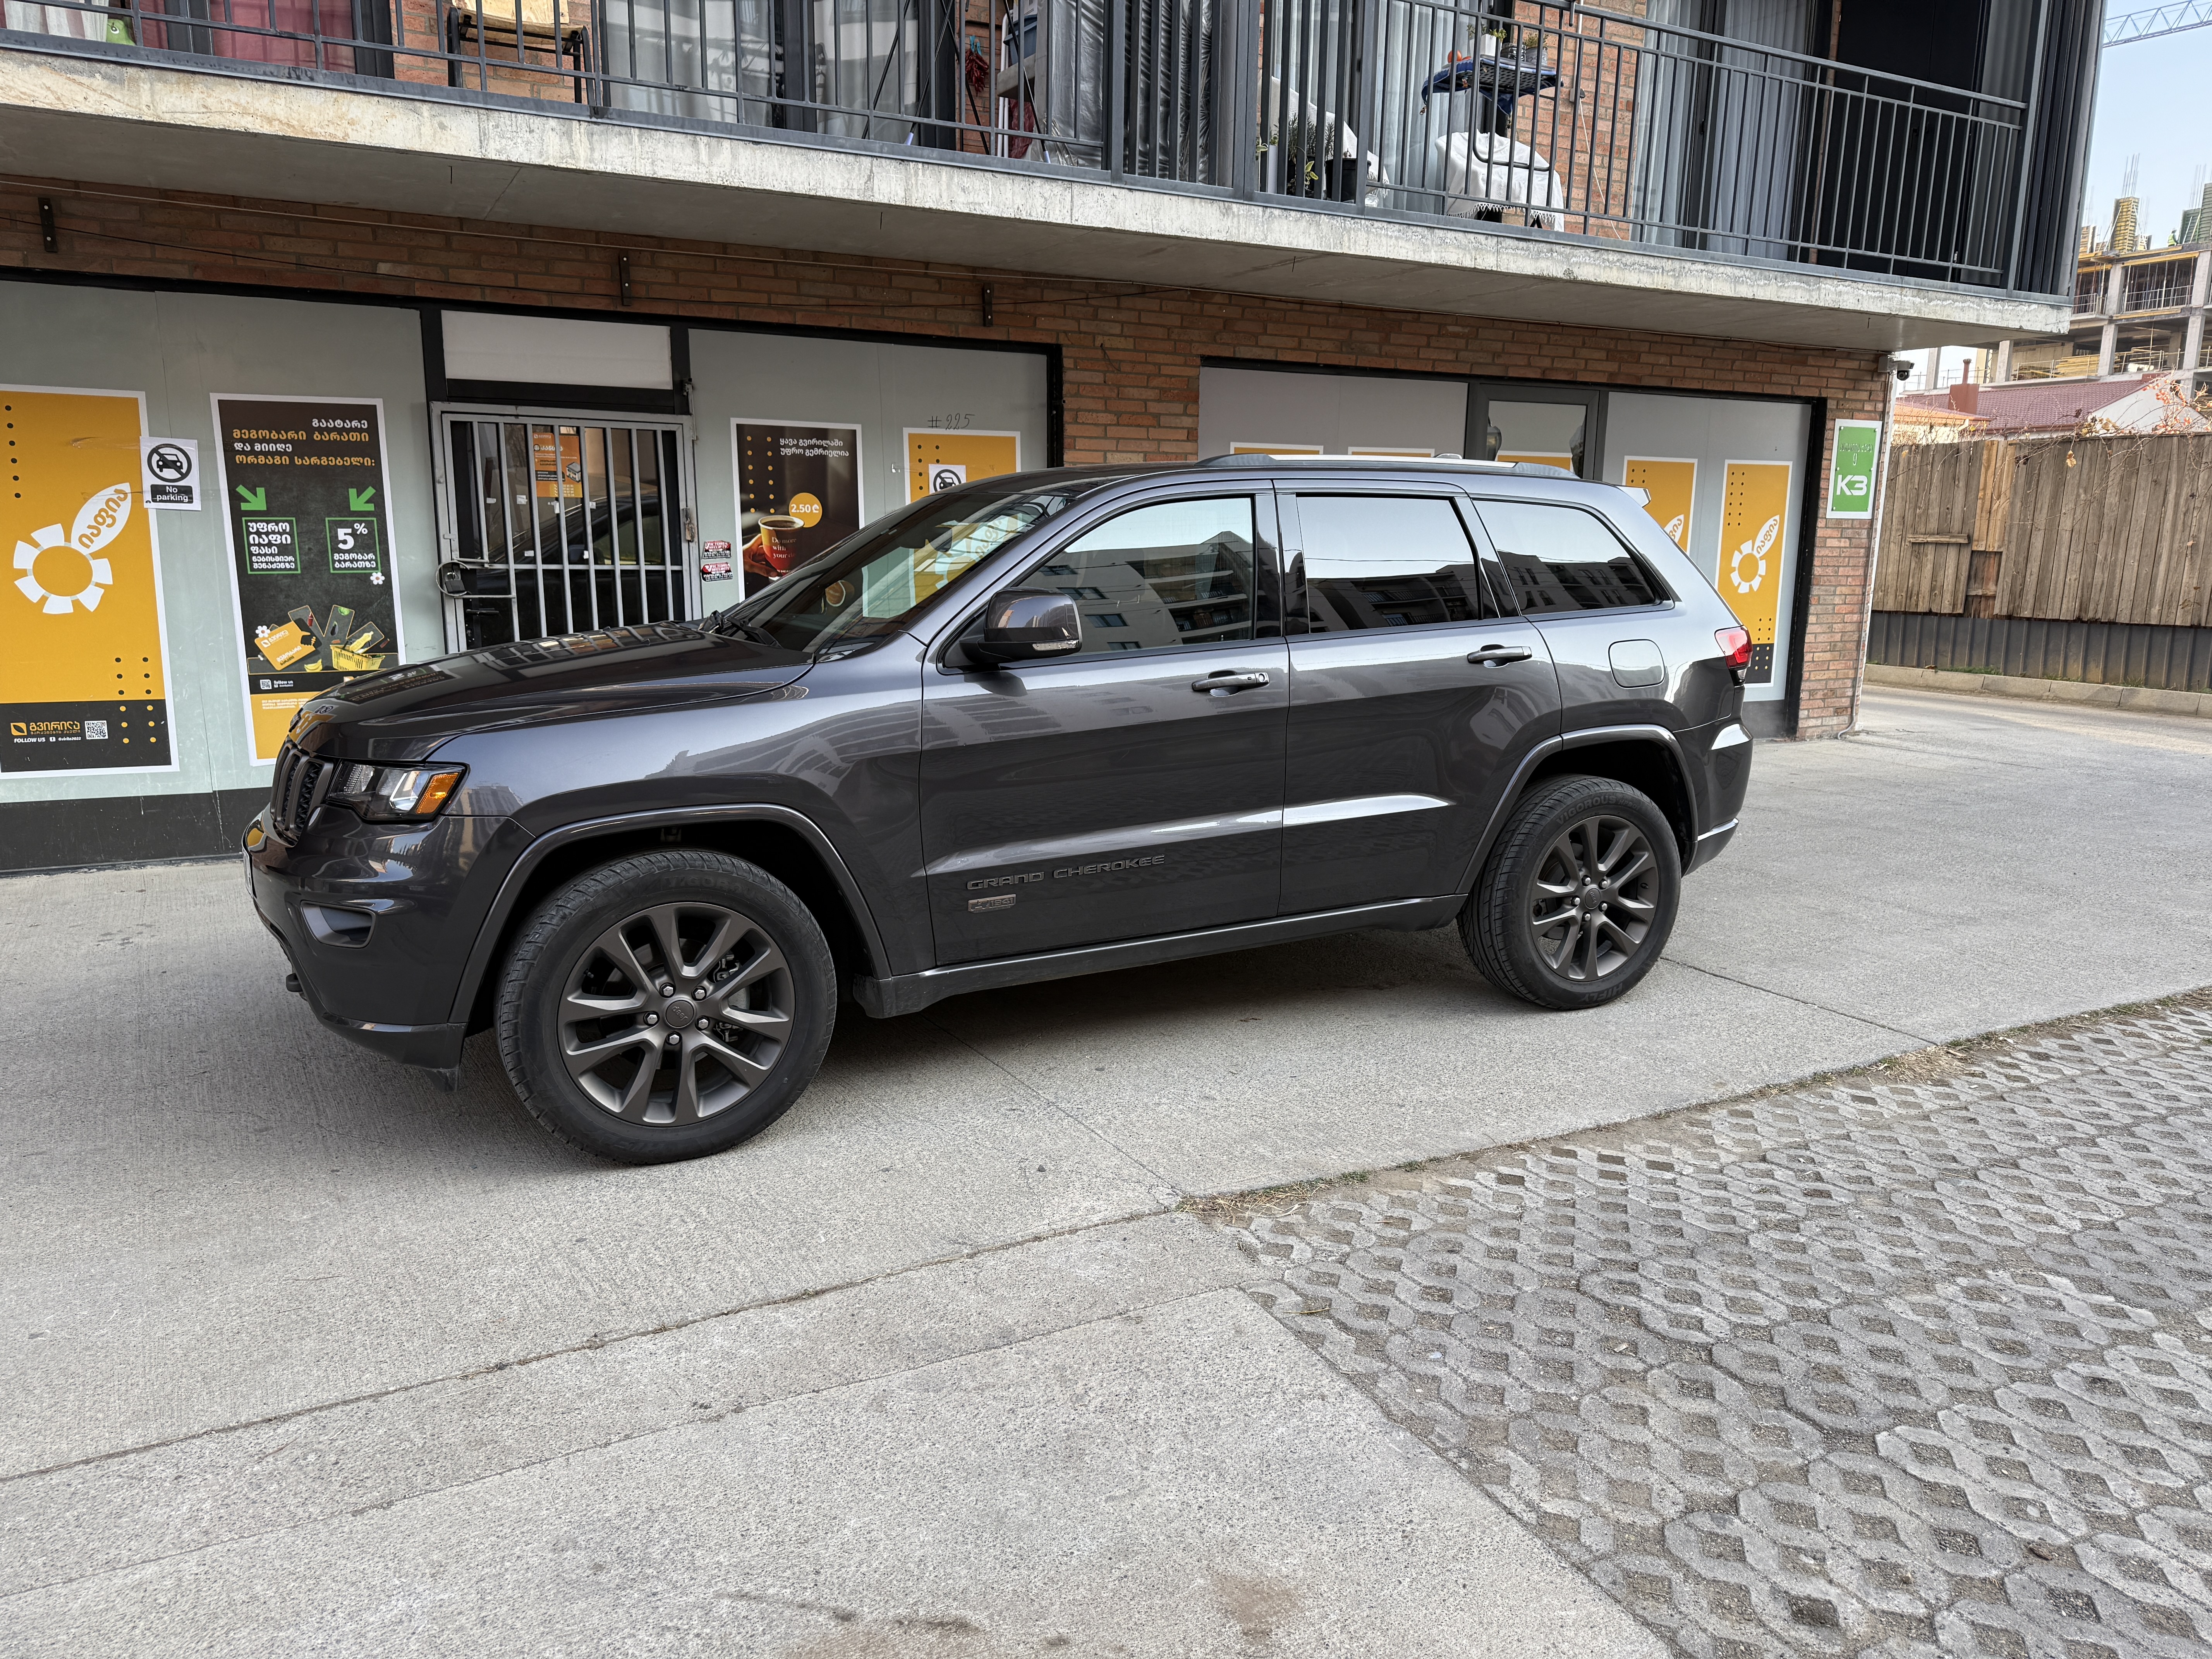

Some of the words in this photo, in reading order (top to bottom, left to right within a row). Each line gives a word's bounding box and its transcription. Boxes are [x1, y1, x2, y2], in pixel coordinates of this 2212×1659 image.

[312, 419, 368, 429] გაატარე
[233, 429, 306, 440] მეგობარი
[313, 431, 369, 441] ბარათი
[234, 443, 251, 451] და
[254, 443, 292, 452] მიიღე
[799, 438, 843, 447] გვირილაში
[780, 447, 804, 455] უფრო
[805, 448, 849, 457] გემრიელია
[235, 455, 289, 464] ორმაგი
[294, 456, 375, 466] სარგებელი:
[1836, 474, 1868, 496] K3
[156, 494, 188, 502] parking
[791, 504, 811, 513] 2.50
[78, 488, 128, 549] იაფია
[248, 522, 290, 532] უფრო
[249, 534, 291, 544] იაფი
[1756, 519, 1778, 555] იაფია
[1556, 795, 1617, 825] VIGOROUS
[967, 872, 1044, 890] GRAND
[1053, 854, 1165, 878] CHEROKEE
[990, 898, 1013, 907] 1941
[672, 1006, 688, 1021] Jeep
